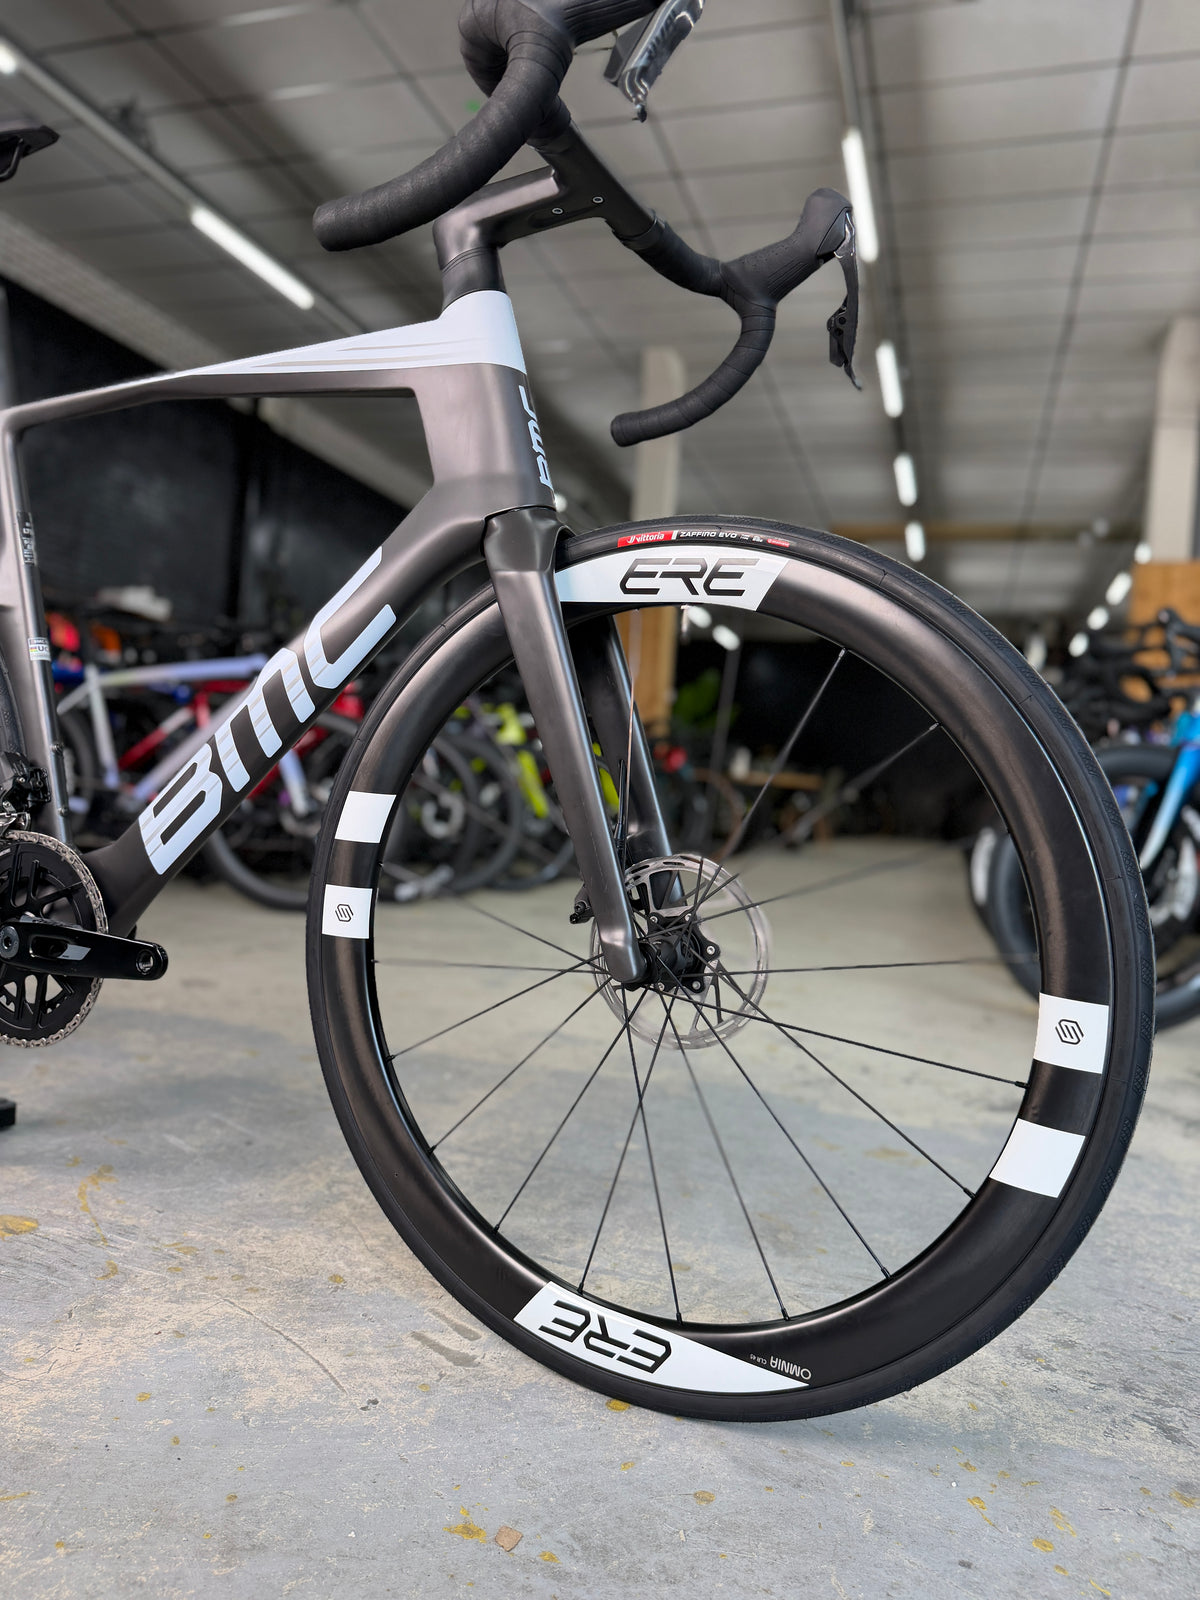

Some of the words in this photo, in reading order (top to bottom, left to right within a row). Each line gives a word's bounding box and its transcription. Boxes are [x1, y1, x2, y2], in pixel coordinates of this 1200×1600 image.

[636, 532, 665, 543] vittoria
[618, 558, 760, 597] ERE
[538, 1300, 672, 1374] ERE
[769, 1356, 812, 1380] OMNIA
